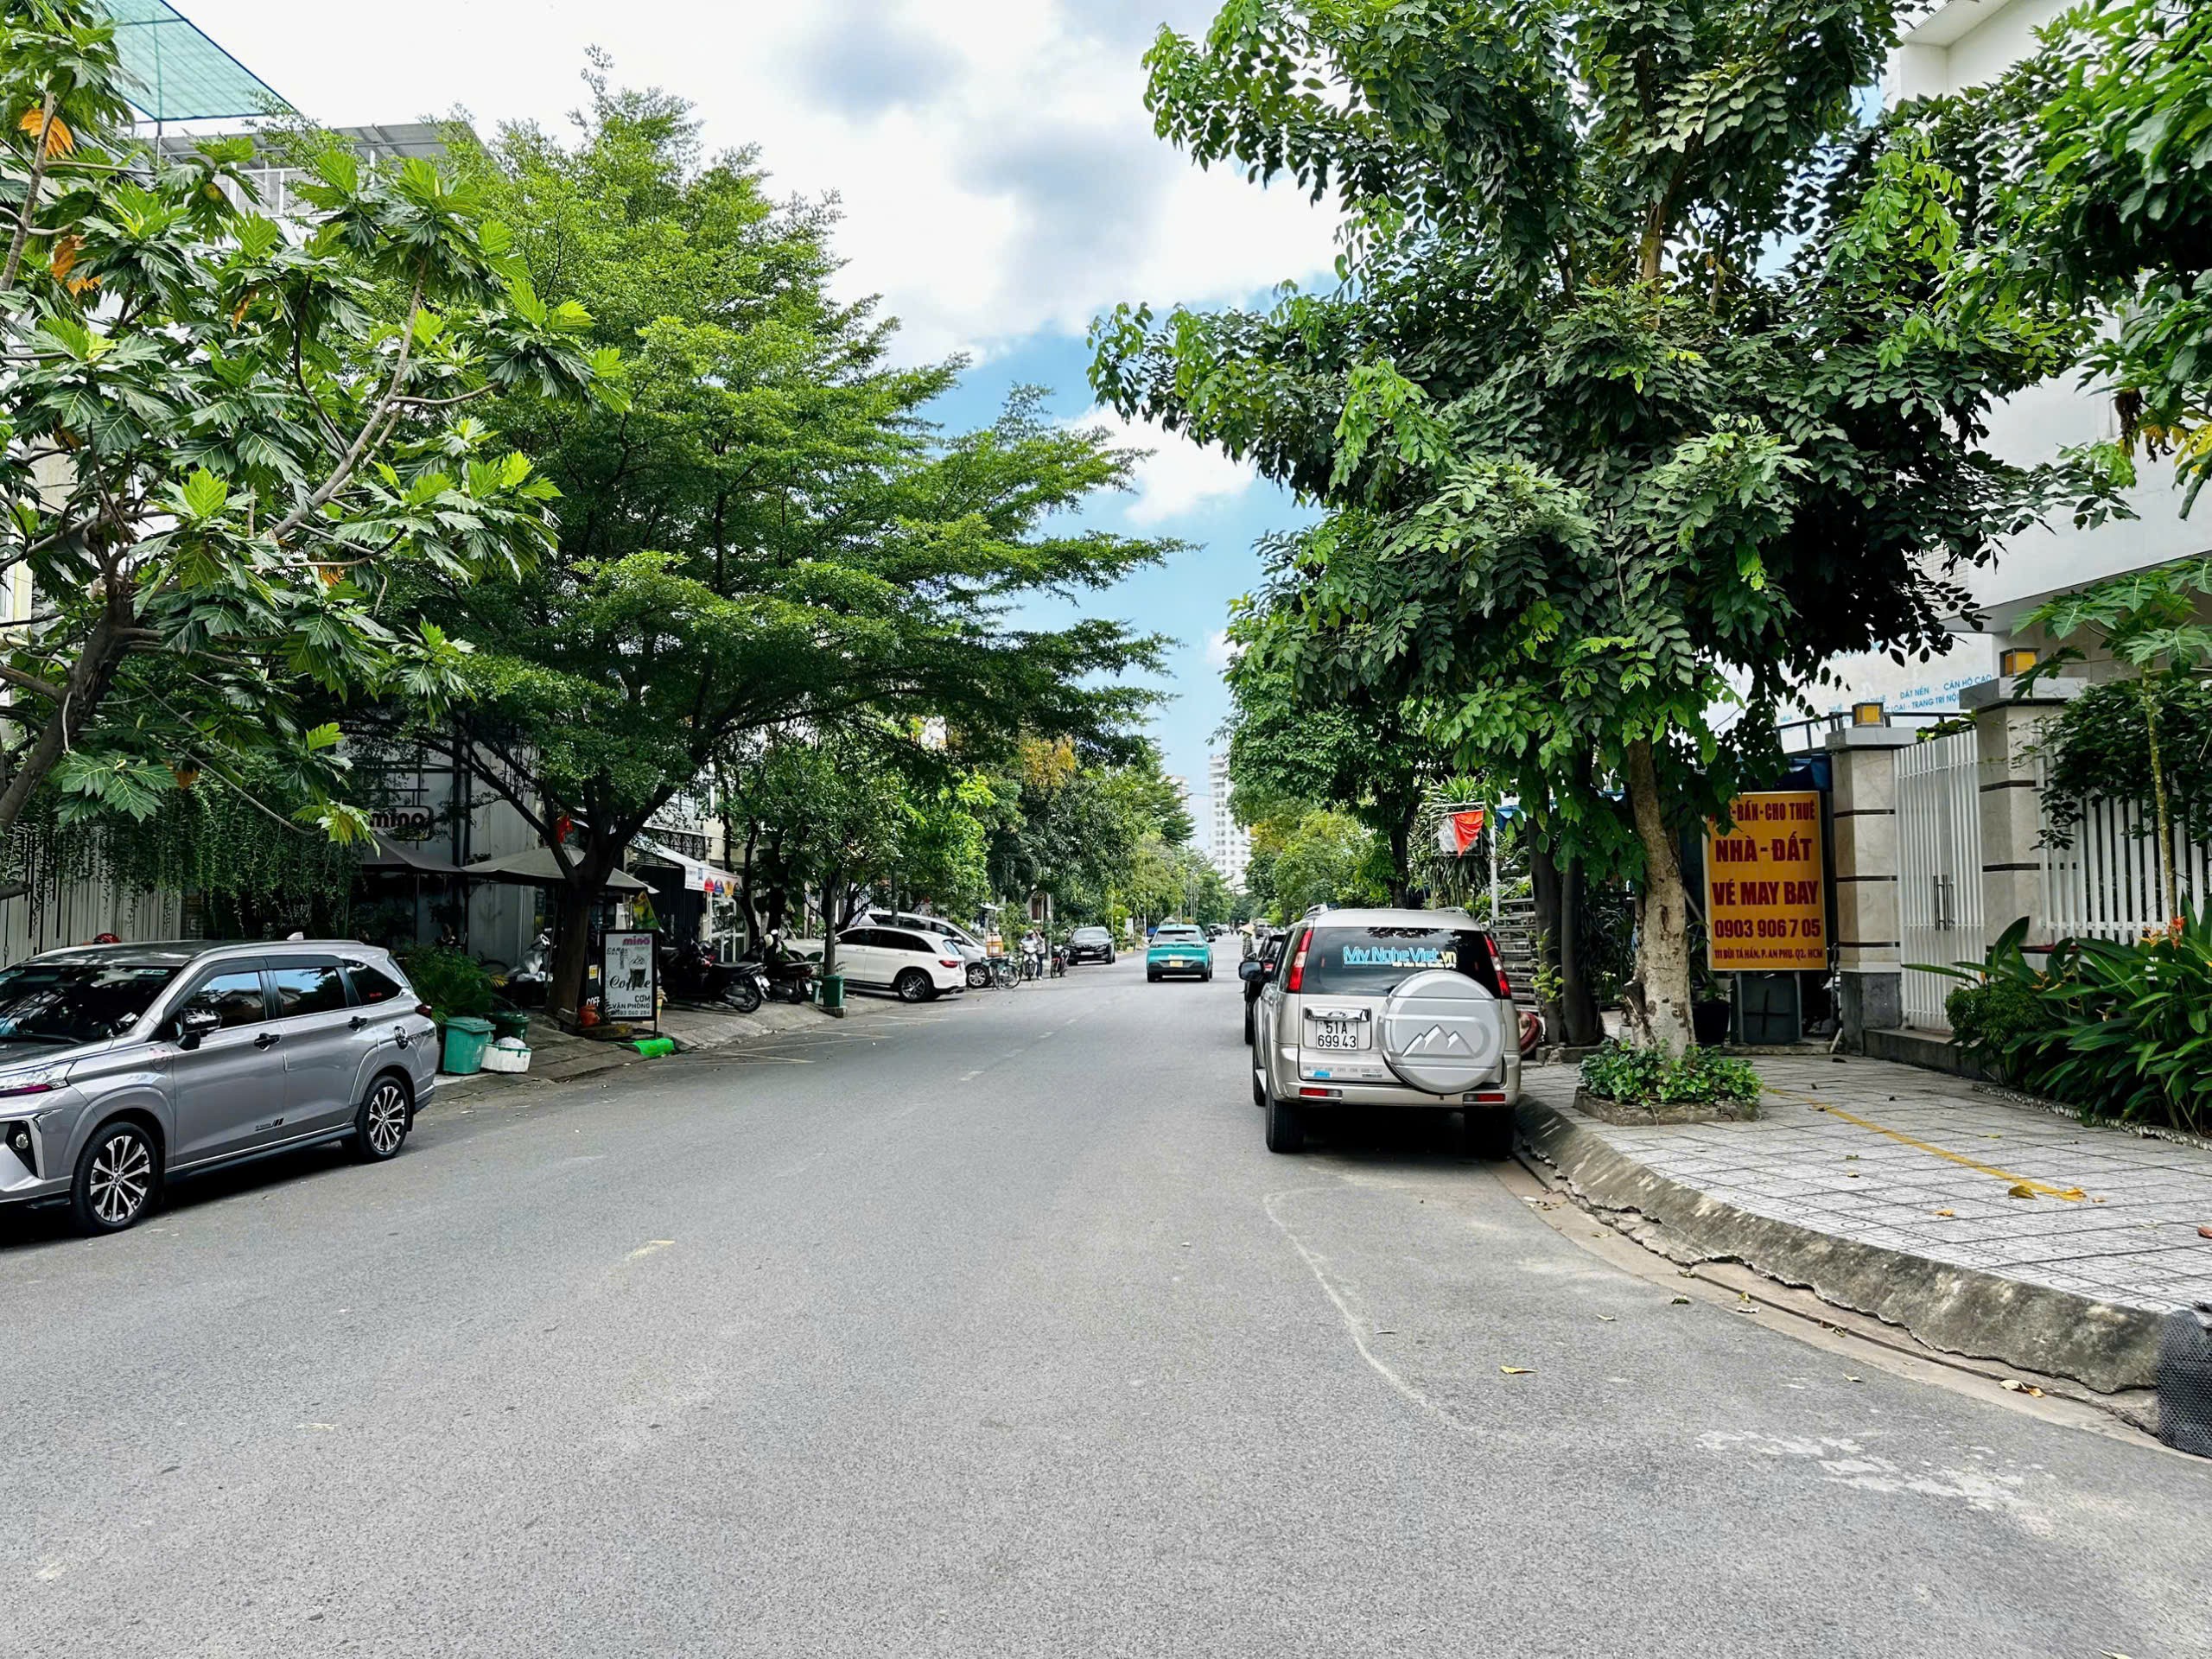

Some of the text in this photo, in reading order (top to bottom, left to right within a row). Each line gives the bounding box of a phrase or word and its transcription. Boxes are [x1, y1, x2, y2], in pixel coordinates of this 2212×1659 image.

[1712, 879, 1819, 906] VÉ MAY BAY
[1714, 919, 1754, 938] 0903
[1757, 918, 1787, 938] 906
